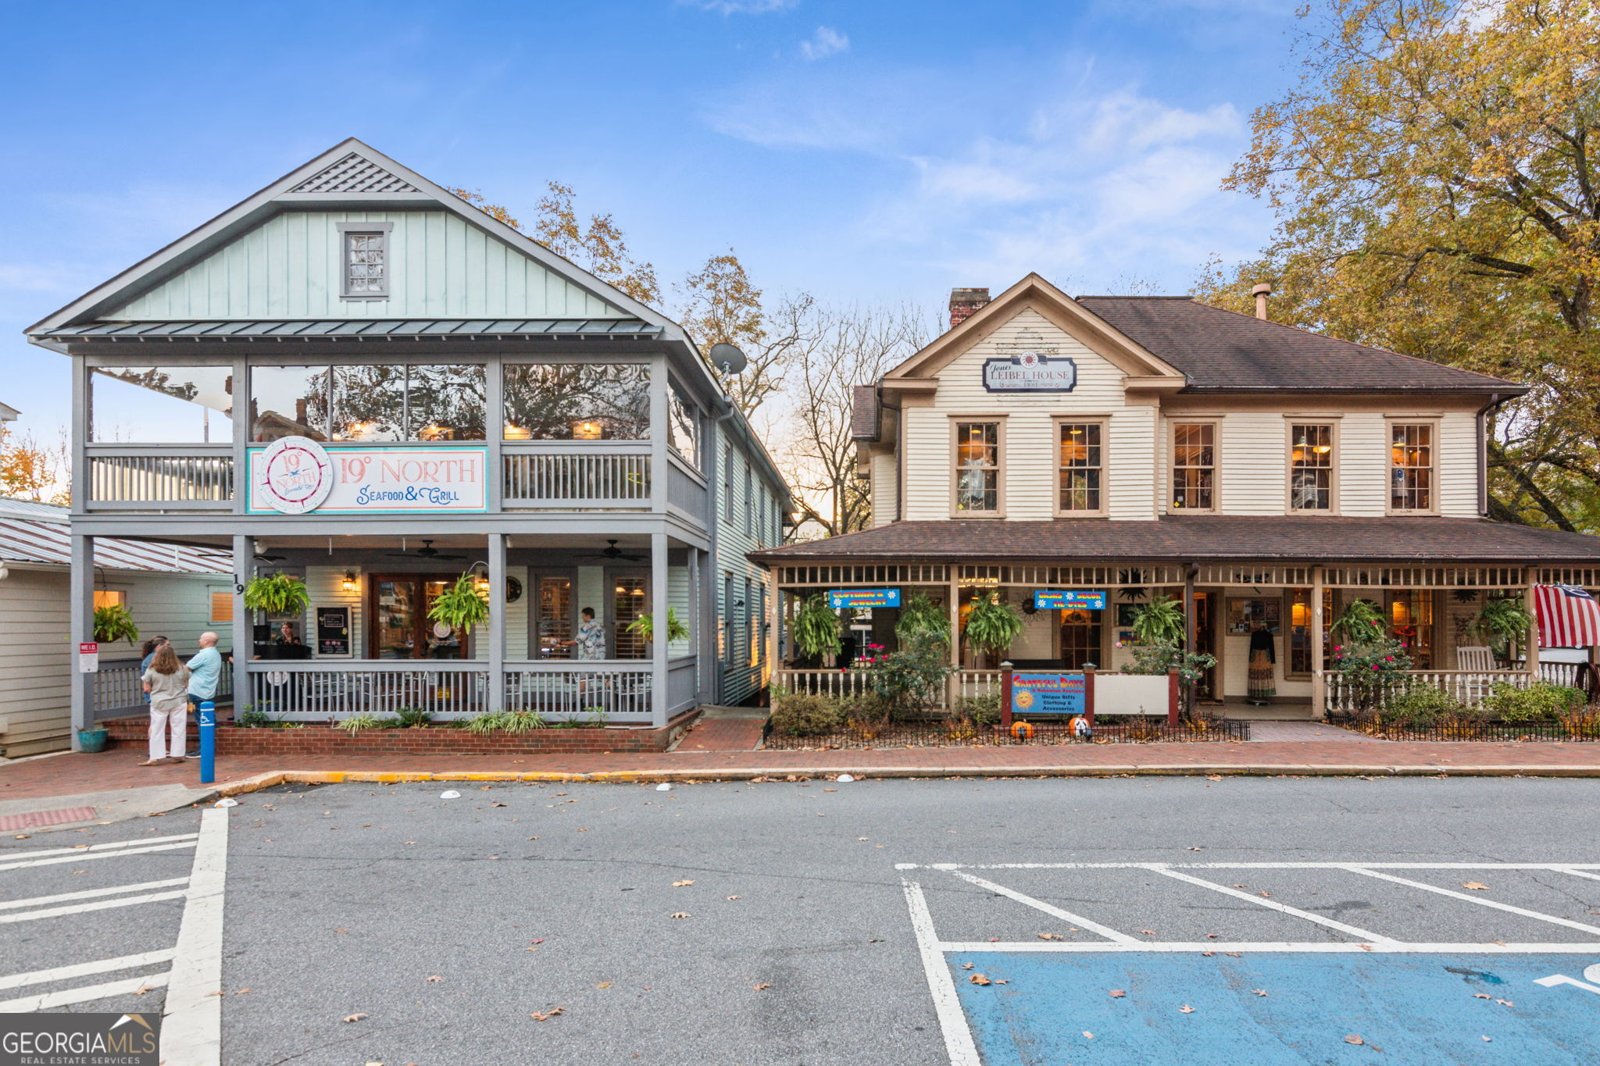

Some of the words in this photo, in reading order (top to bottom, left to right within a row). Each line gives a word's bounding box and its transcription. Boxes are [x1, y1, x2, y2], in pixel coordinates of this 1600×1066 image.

[990, 371, 1028, 380] LEIBEL
[1032, 371, 1070, 380] HOUSE
[275, 471, 316, 489] NORTH
[380, 459, 476, 483] NORTH
